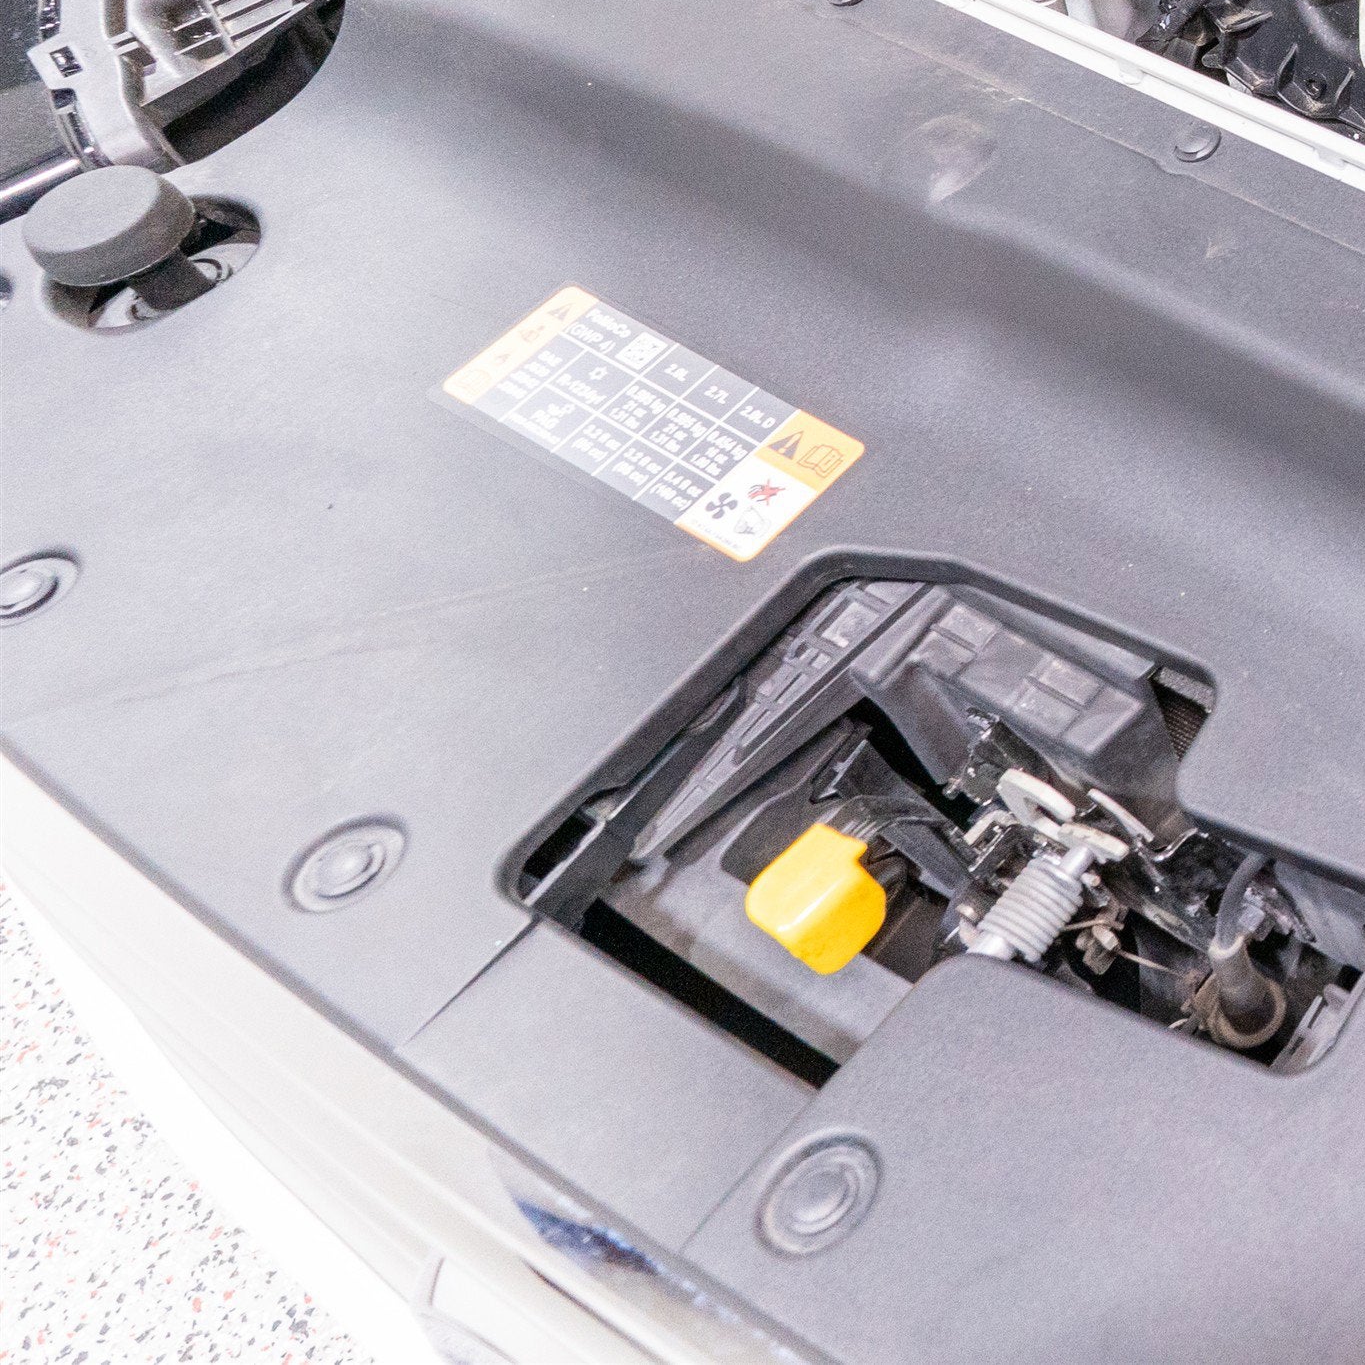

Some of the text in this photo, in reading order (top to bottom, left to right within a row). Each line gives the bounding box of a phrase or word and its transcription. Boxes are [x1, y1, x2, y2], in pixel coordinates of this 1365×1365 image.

[562, 320, 604, 347] (GWP
[552, 373, 607, 407] R-1234yf
[702, 384, 733, 404] 2.7L
[528, 409, 561, 430] PAG
